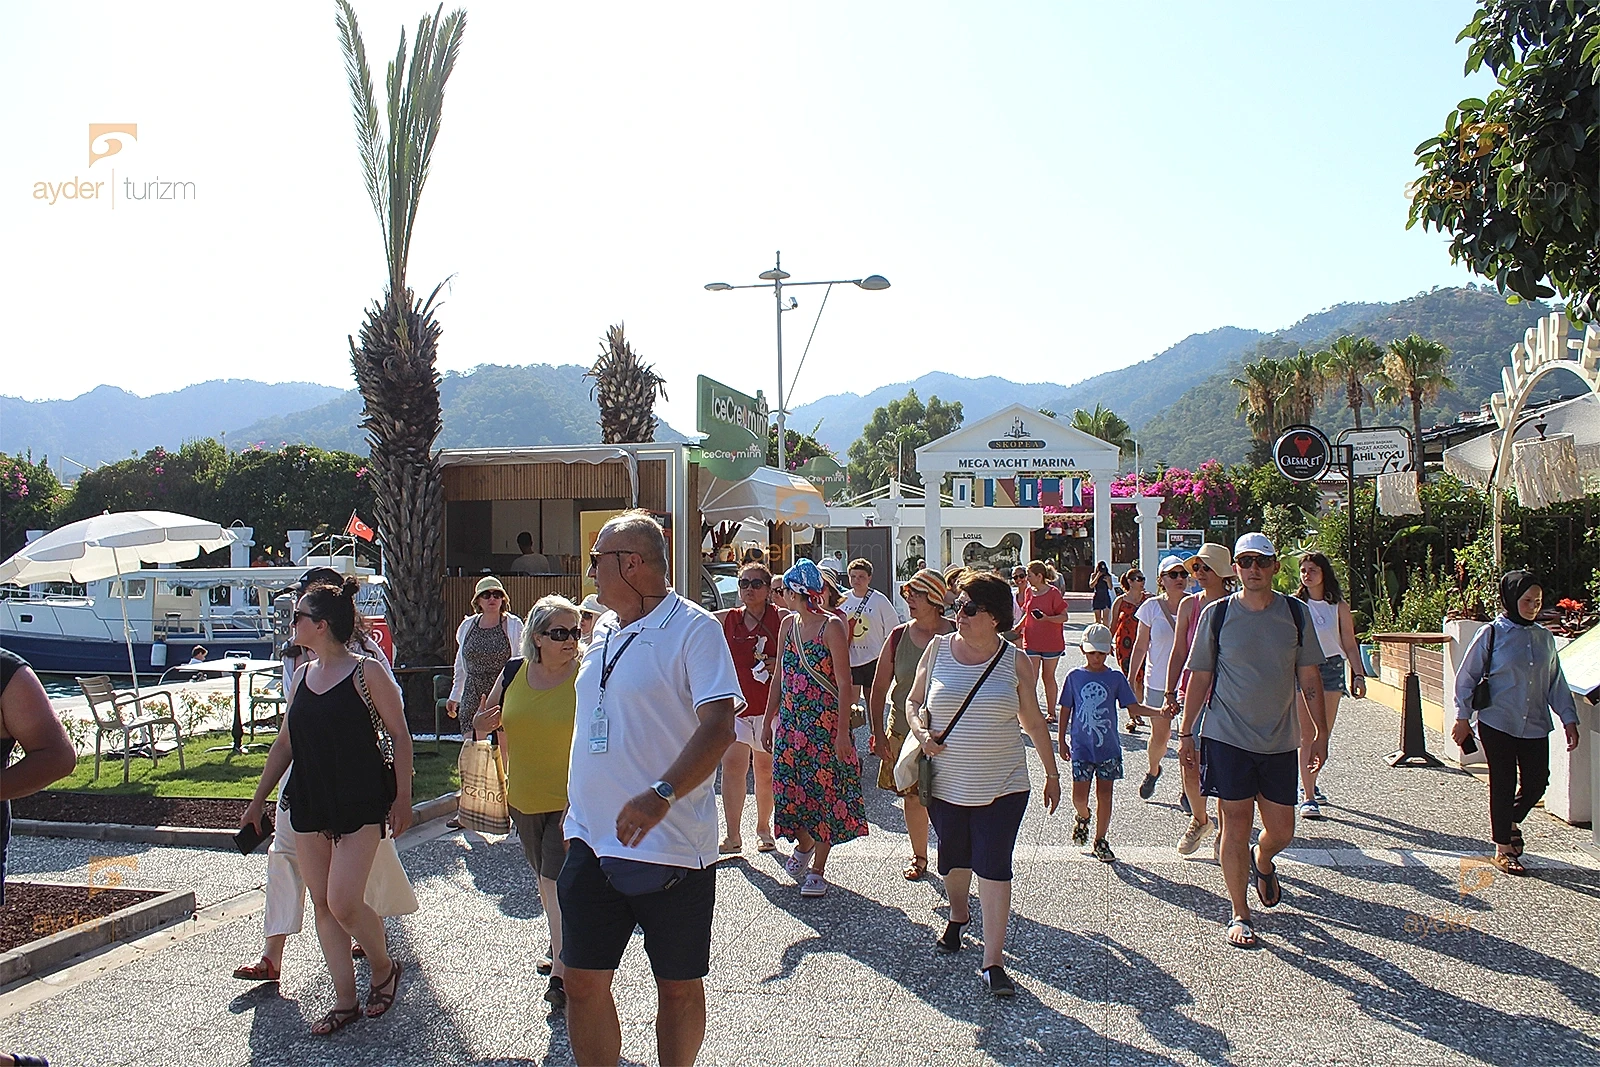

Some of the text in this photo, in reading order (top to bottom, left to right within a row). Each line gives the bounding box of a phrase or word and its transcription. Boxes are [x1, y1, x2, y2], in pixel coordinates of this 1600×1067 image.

[995, 441, 1039, 449] SKOPEA
[1352, 450, 1376, 461] AHİL
[958, 458, 1076, 468] MEGA YACHT MARINA
[962, 533, 983, 541] Lotus
